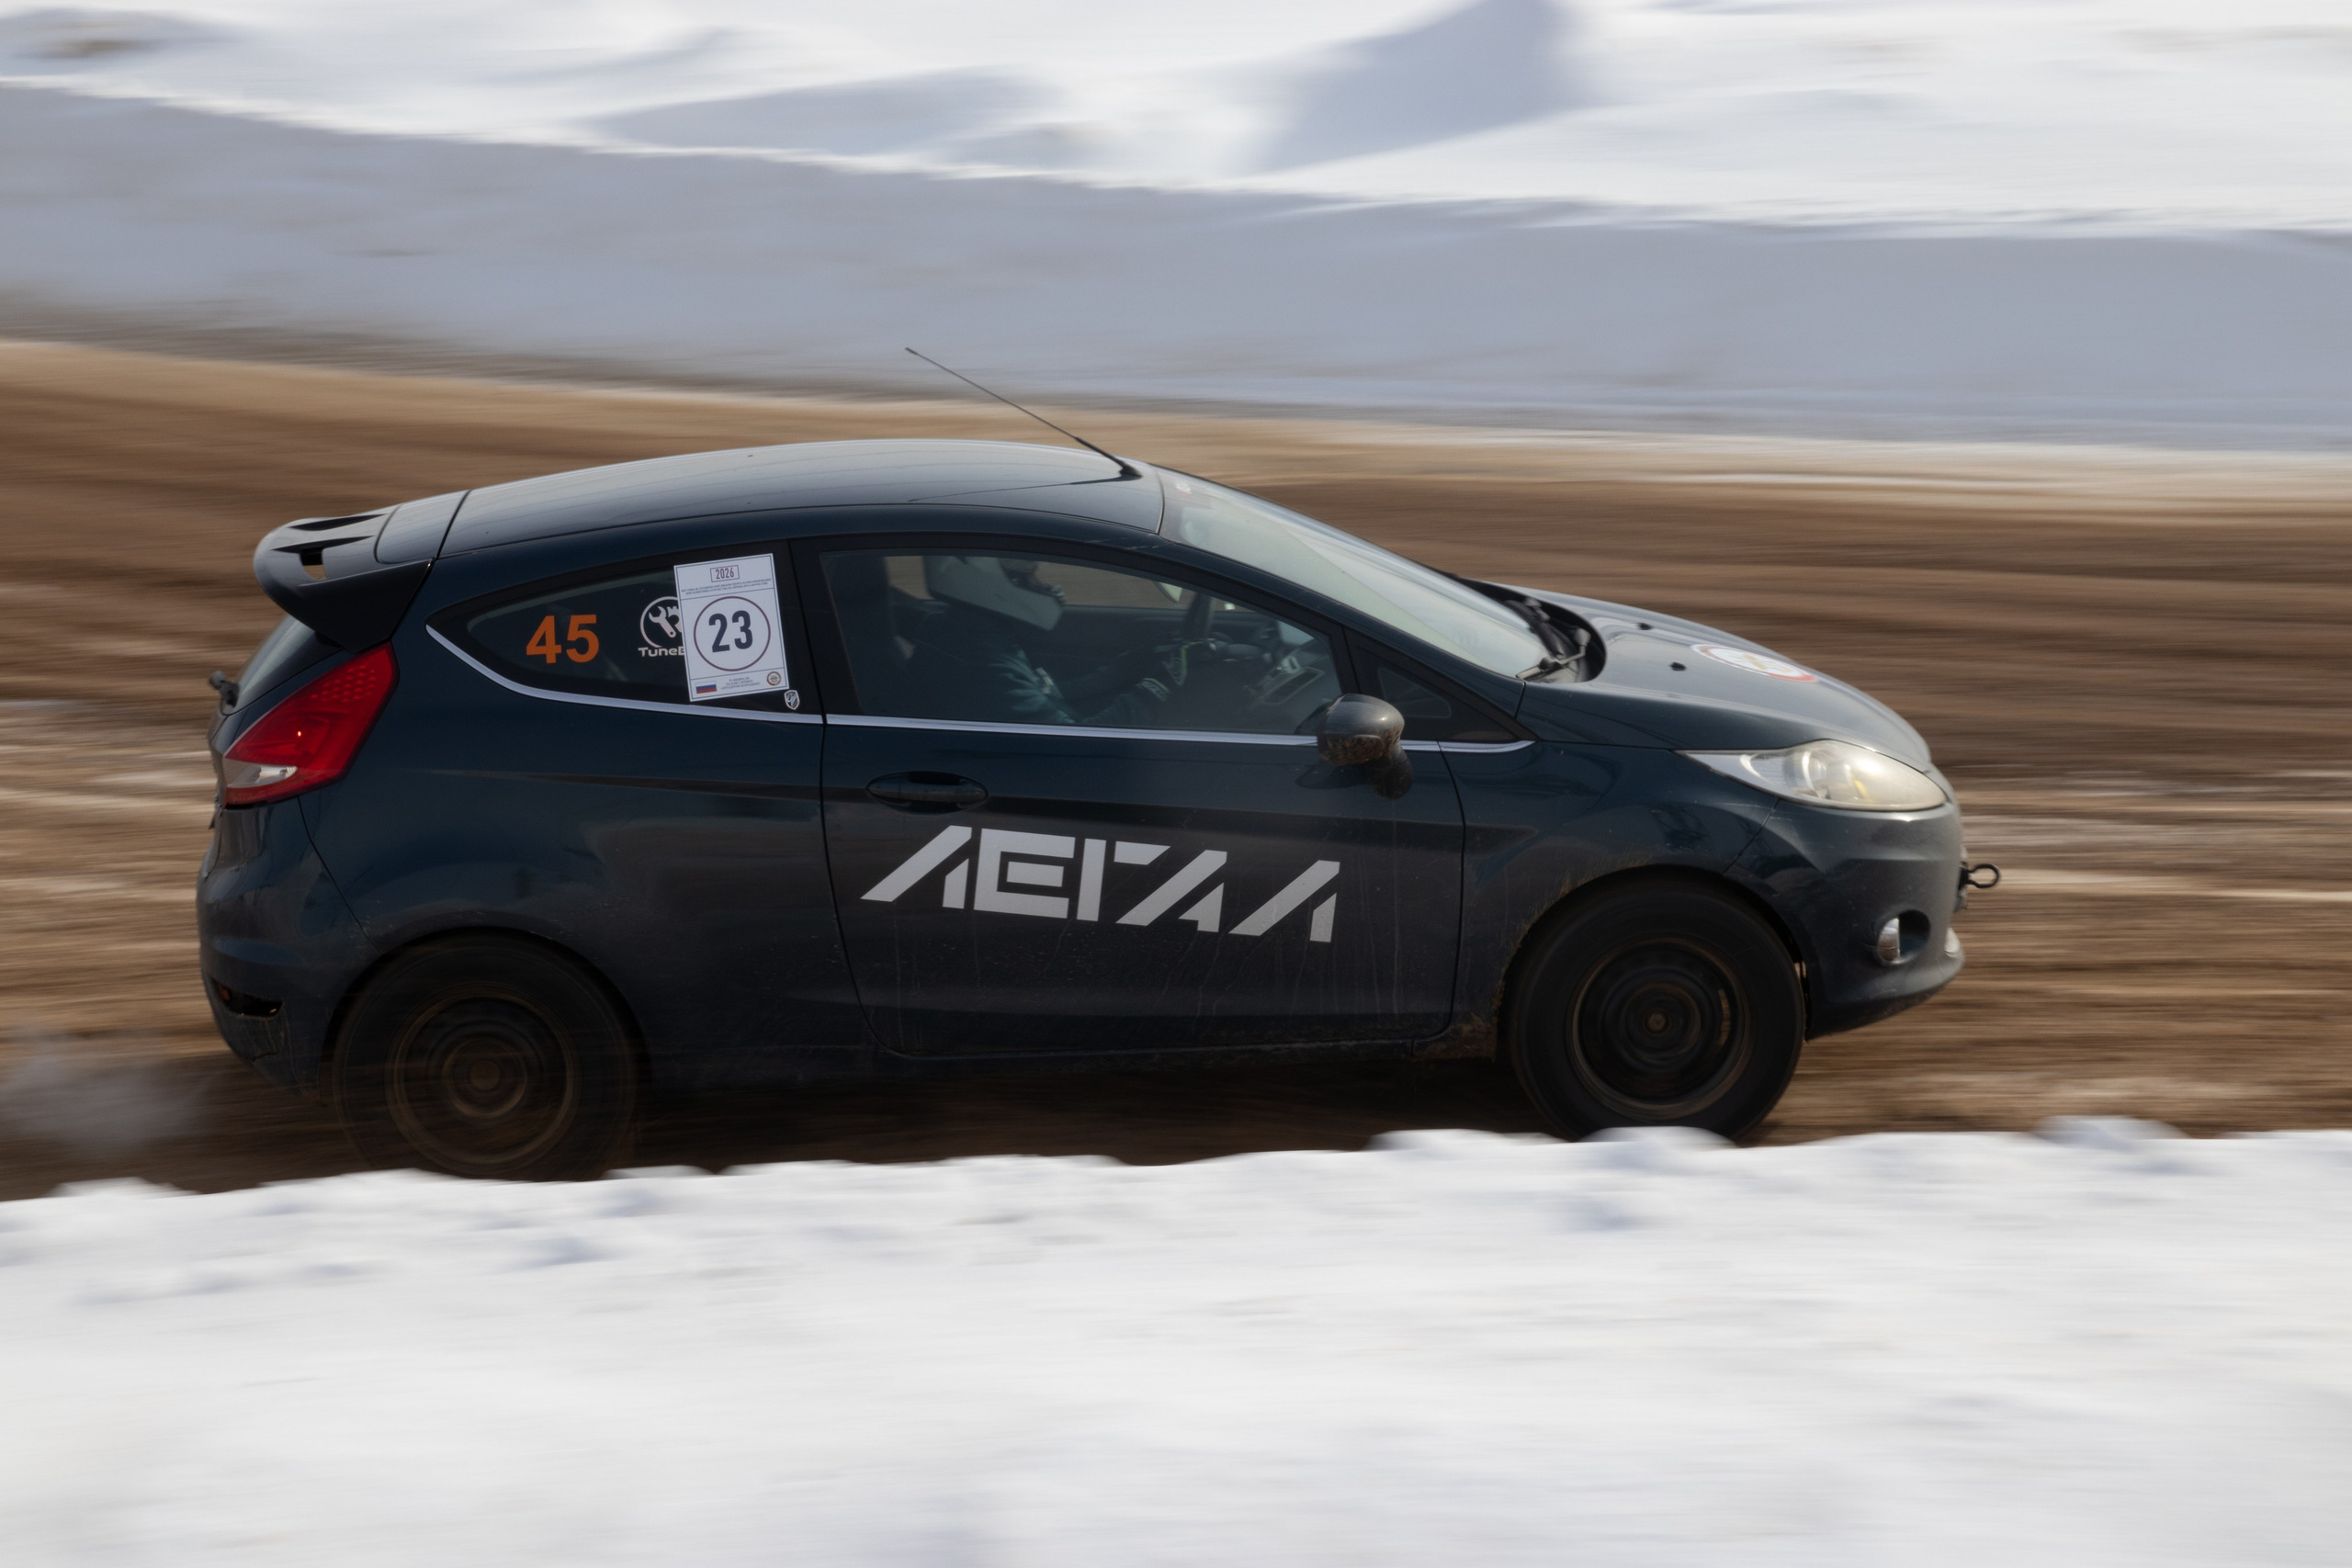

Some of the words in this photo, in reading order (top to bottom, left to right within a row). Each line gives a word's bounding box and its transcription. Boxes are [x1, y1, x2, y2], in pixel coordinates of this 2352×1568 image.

[716, 568, 734, 580] 2026
[526, 615, 600, 664] 45
[708, 610, 753, 653] 23
